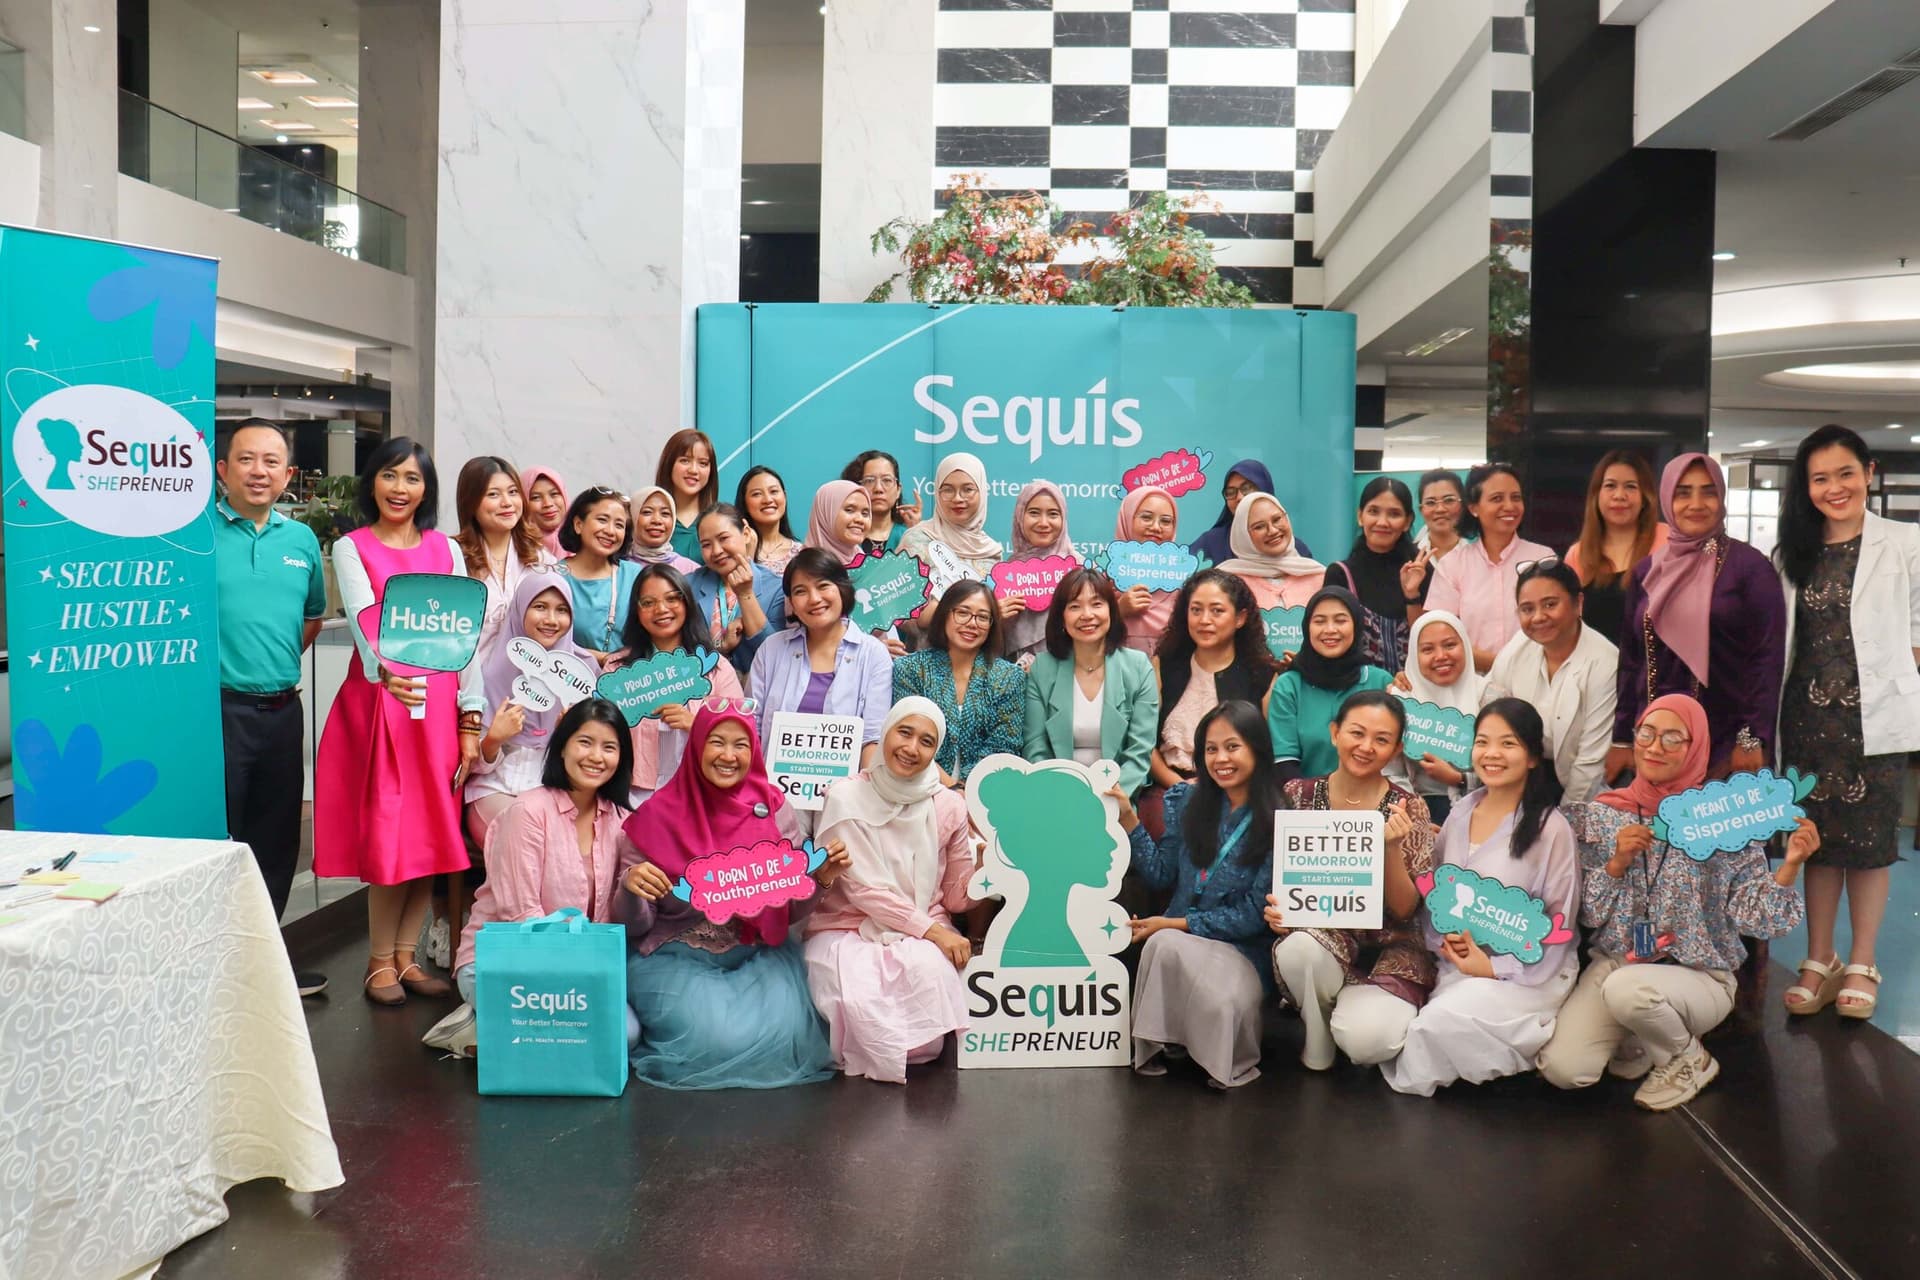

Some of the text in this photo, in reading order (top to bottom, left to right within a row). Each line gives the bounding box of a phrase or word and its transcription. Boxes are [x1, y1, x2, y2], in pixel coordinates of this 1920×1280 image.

[913, 374, 1143, 464] Sequis
[87, 429, 193, 475] Sequis
[87, 475, 194, 493] SHEPRENEUR
[913, 476, 936, 496] Yo
[56, 560, 174, 589] SECURE
[870, 571, 912, 599] Sequis
[1016, 572, 1040, 586] BORN
[59, 599, 175, 630] HUSTLE
[390, 605, 473, 634] Hustle
[1270, 622, 1304, 638] Sequ
[47, 638, 198, 674] EMPOWER
[512, 641, 543, 668] Sequis
[549, 659, 591, 695] Sequis
[623, 674, 652, 694] PROUD
[518, 680, 550, 707] Sequis
[616, 677, 695, 711] Mompreneur
[781, 733, 853, 750] BETTER
[820, 723, 855, 734] YOUR
[780, 749, 851, 762] TOMORROW
[816, 767, 833, 775] WITH
[777, 775, 833, 801] Sequ
[1693, 796, 1730, 819] MEANT
[1747, 788, 1763, 805] BE
[1333, 821, 1374, 833] YOUR
[1683, 804, 1786, 841] Sispreneur
[1288, 836, 1374, 852] BETTER
[717, 866, 748, 887] BORN
[766, 859, 781, 877] BE
[1288, 855, 1373, 867] TOMORROW
[703, 874, 801, 905] Youthpreneur
[1332, 876, 1354, 884] WITH
[1288, 888, 1366, 918] Sequis
[1473, 896, 1529, 932] Sequis
[1469, 915, 1524, 943] SHEPRENEUR
[510, 985, 588, 1016] Sequis
[967, 970, 1122, 1030] Sequis
[965, 1031, 1122, 1053] SHEPRENEUR
